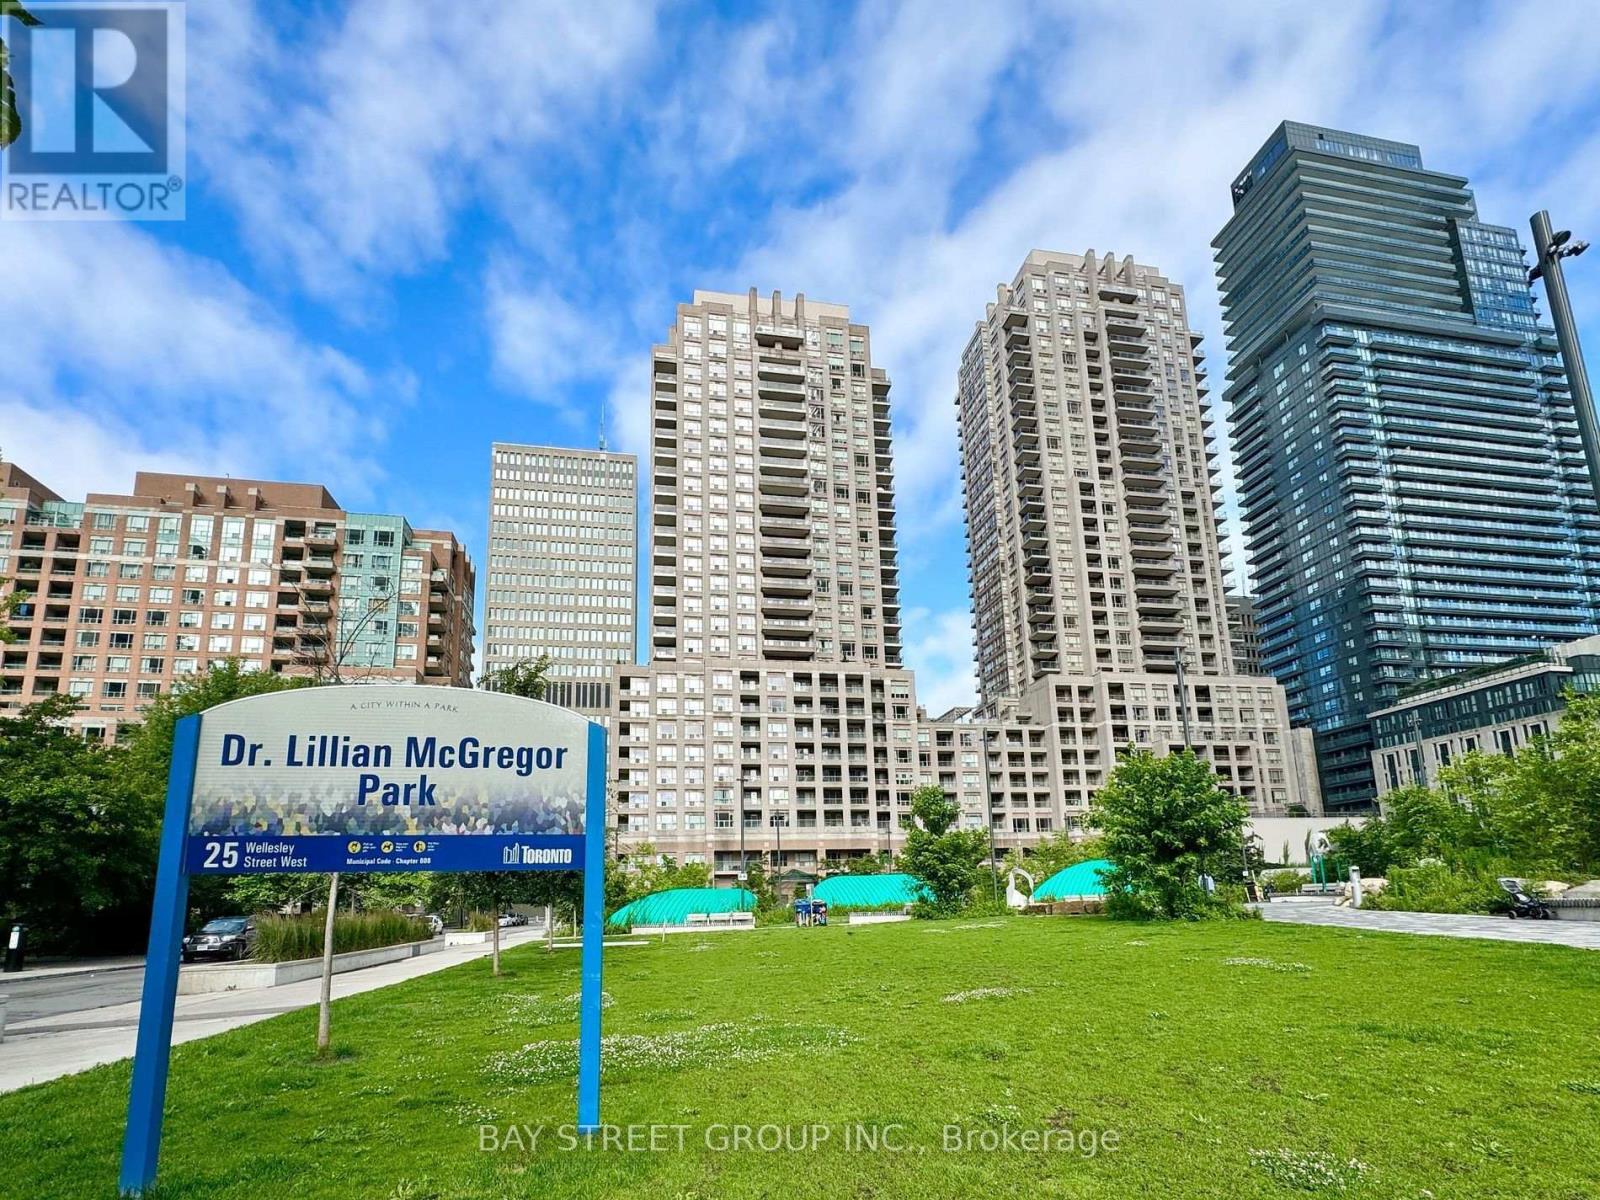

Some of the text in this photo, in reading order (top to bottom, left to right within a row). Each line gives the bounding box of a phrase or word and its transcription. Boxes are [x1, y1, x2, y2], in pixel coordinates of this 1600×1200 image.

[360, 701, 382, 710] CITY
[386, 700, 421, 708] WITHIN
[424, 701, 430, 709] A
[434, 702, 459, 713] PARK
[221, 734, 568, 777] Dr. Lillian McGregor
[357, 774, 437, 807] Park
[203, 842, 239, 868] 25
[245, 841, 295, 855] Wellesley
[522, 845, 572, 864] TORONTO
[243, 856, 307, 868] Street West
